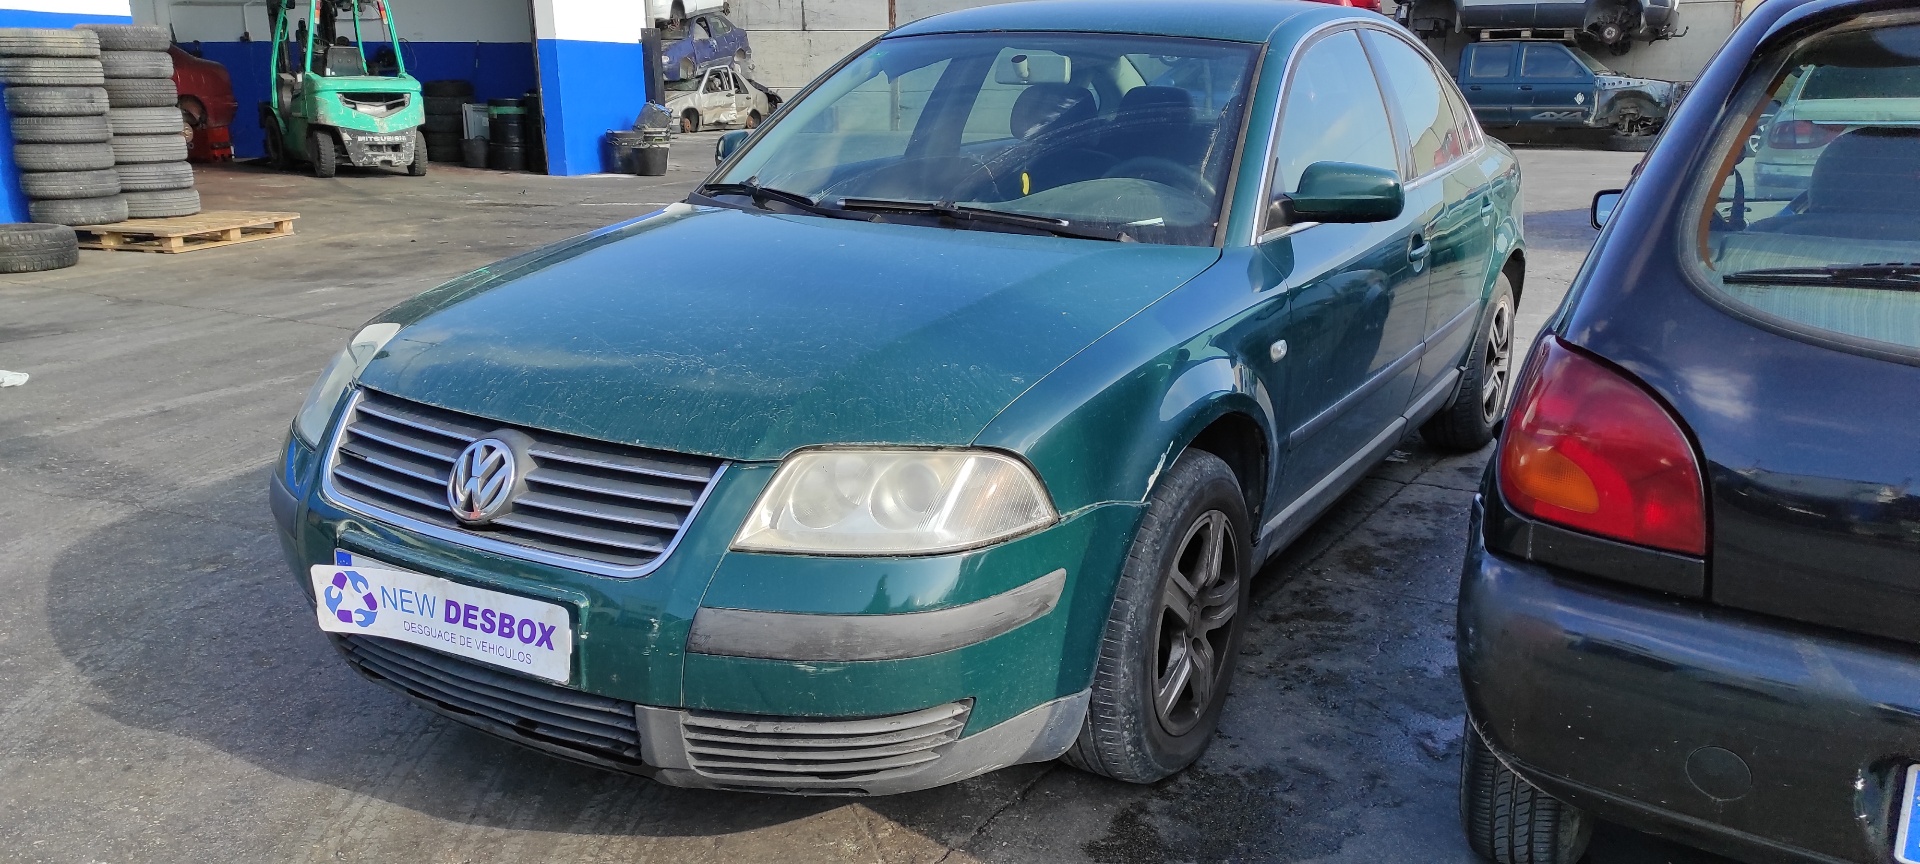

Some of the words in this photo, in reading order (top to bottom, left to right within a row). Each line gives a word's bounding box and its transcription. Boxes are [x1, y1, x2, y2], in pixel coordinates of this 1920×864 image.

[380, 585, 437, 619] NEW
[444, 599, 557, 651] DESBOX
[403, 621, 457, 644] DESGUACE
[459, 635, 472, 648] DE
[475, 638, 533, 665] VEHICULOS
